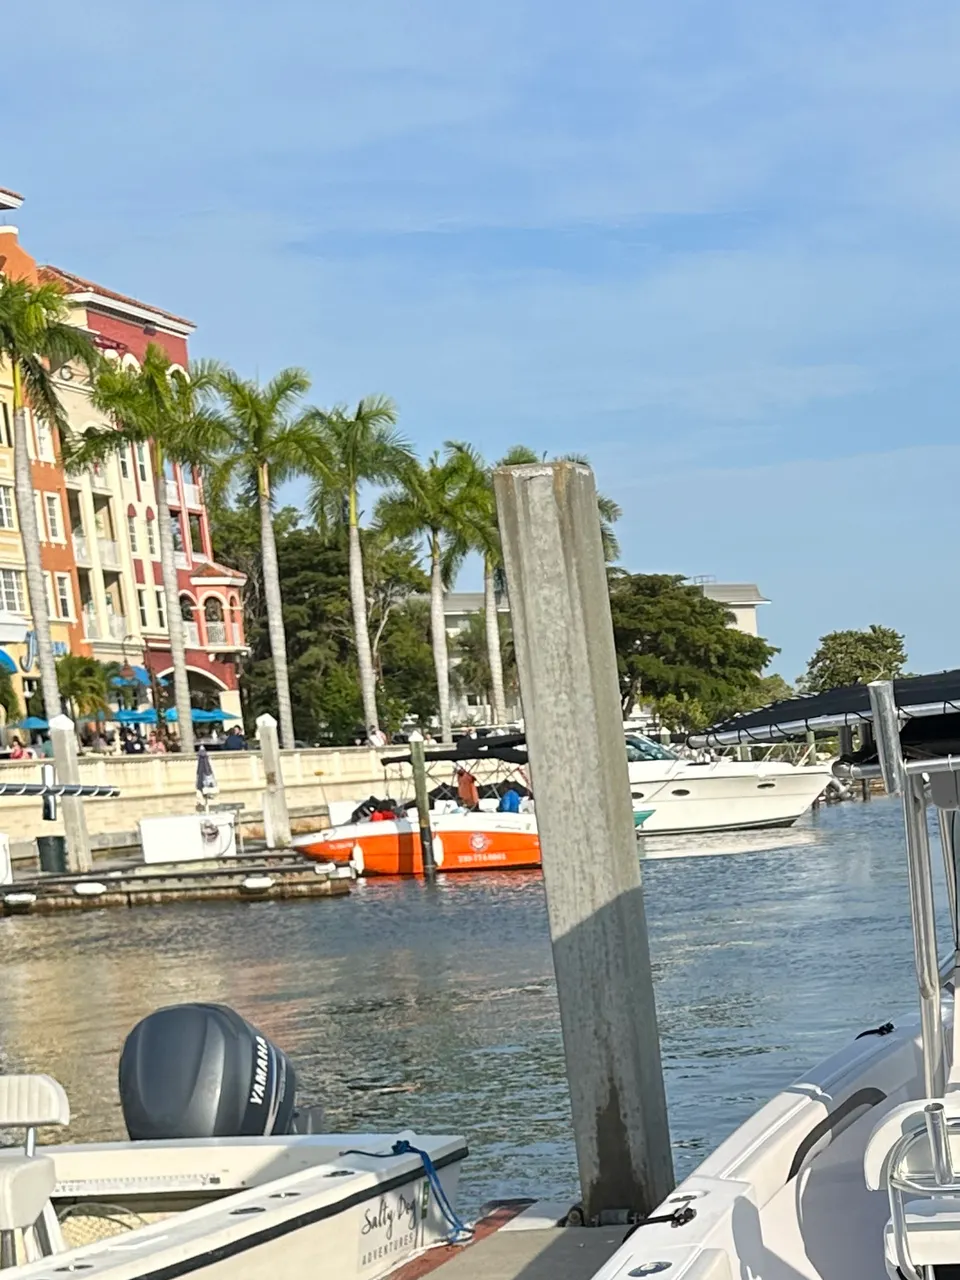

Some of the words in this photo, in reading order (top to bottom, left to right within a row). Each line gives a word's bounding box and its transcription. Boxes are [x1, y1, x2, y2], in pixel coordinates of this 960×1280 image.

[250, 1035, 268, 1105] YAMAHA
[361, 1197, 393, 1240] Salty
[362, 1231, 414, 1265] ADVENTURES
